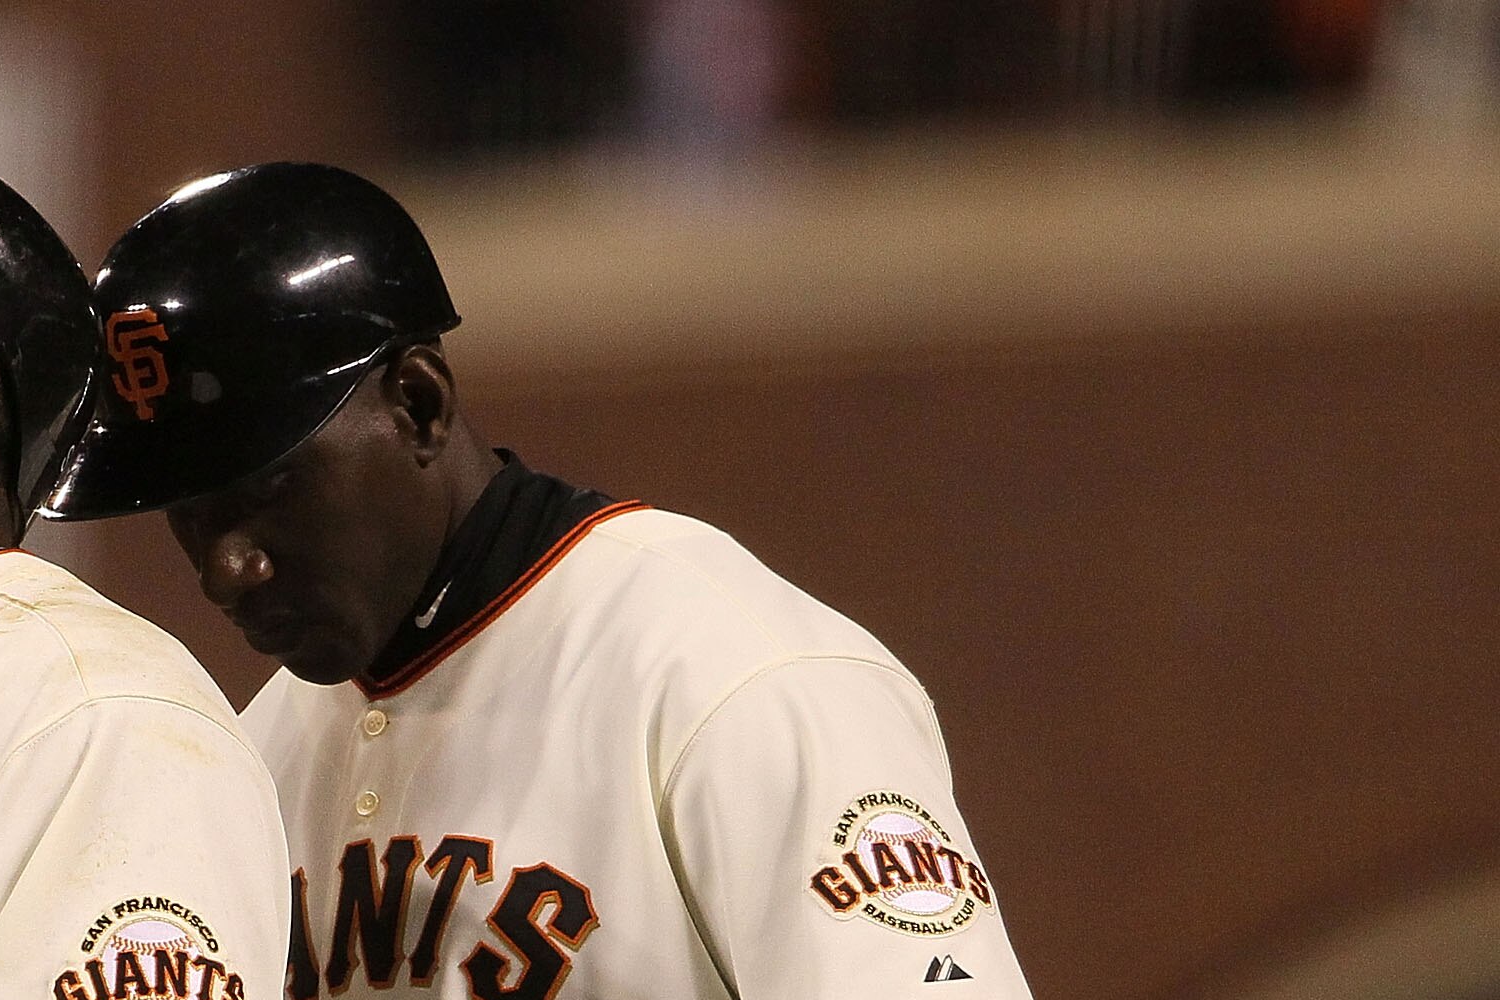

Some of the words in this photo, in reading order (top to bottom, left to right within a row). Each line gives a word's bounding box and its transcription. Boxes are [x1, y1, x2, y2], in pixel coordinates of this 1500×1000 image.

[833, 808, 858, 845] SAN
[857, 791, 951, 843] FRANCISCO
[810, 837, 991, 913] GIANTS
[80, 914, 113, 953] SAN
[112, 896, 219, 953] FRANCISCO
[862, 903, 953, 934] BASEBALL
[953, 898, 975, 926] CLUB
